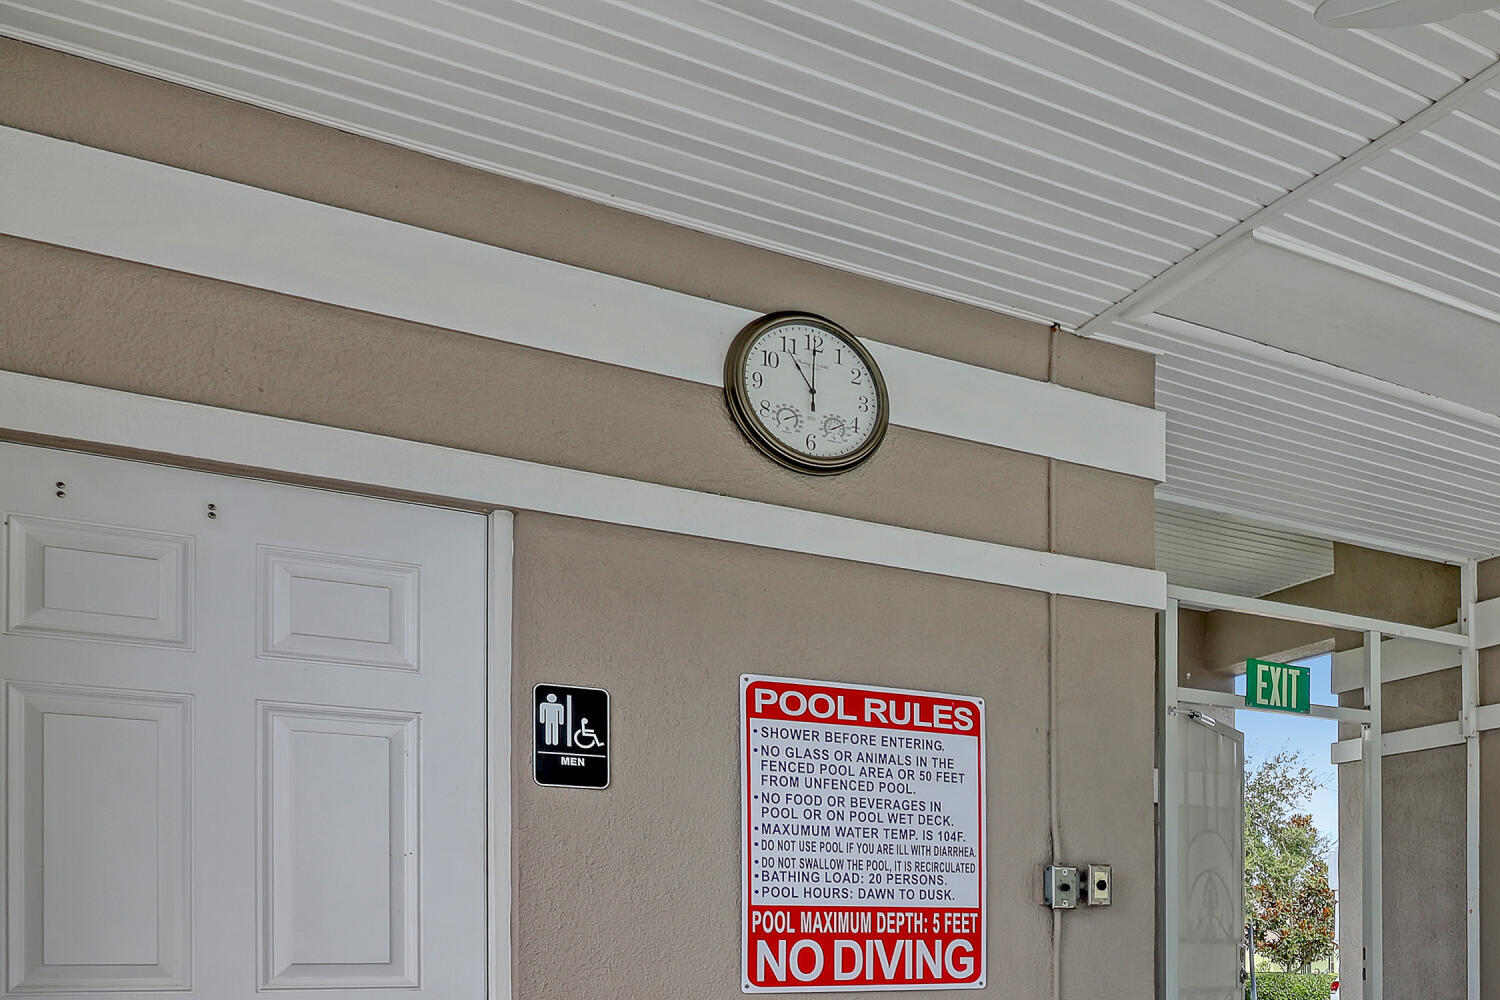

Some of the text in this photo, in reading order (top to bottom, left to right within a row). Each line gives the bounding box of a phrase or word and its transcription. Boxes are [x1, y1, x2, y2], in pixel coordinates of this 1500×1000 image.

[780, 336, 798, 355] 11
[804, 334, 824, 353] 12
[761, 350, 779, 368] 10
[836, 349, 842, 365] 1
[752, 372, 763, 389] 9
[851, 368, 862, 385] 2
[760, 400, 770, 417] 8
[858, 396, 868, 412] 3
[850, 417, 860, 433] 4
[806, 434, 816, 450] 6
[1257, 664, 1300, 708] EXIT
[755, 688, 974, 730] POOL RULES
[761, 727, 944, 751] SHOWER BEFORE ENTERING.
[561, 757, 585, 766] MEN
[761, 745, 954, 769] NO GLASS OR ANIMALS IN THE
[761, 760, 965, 784] FENCED POOL AREA OR 50 FEET
[761, 774, 916, 794] FROM UNFENCED POOL.
[761, 792, 941, 812] NO FOOD OR BEVERAGES IN
[761, 807, 953, 827] POOL OR ON POOL WET DECK.
[761, 824, 966, 842] MAXUMUM WATER TEMP. IS 104F.
[761, 840, 976, 858] DO NOT USE POOL IF YOU ARE ILL WITH DIARRHEA.
[761, 857, 976, 874] DO NOT SWALLOW THE POOL, IT IS RECIRCULATED
[762, 871, 947, 885] BATHING LOAD: 20 PERSONS.
[762, 887, 955, 901] POOL HOURS: DAWN TO DUSK.
[752, 910, 978, 934] POOL MAXIMUM DEPTH: 5 FEET
[756, 938, 974, 982] NO DIVING
